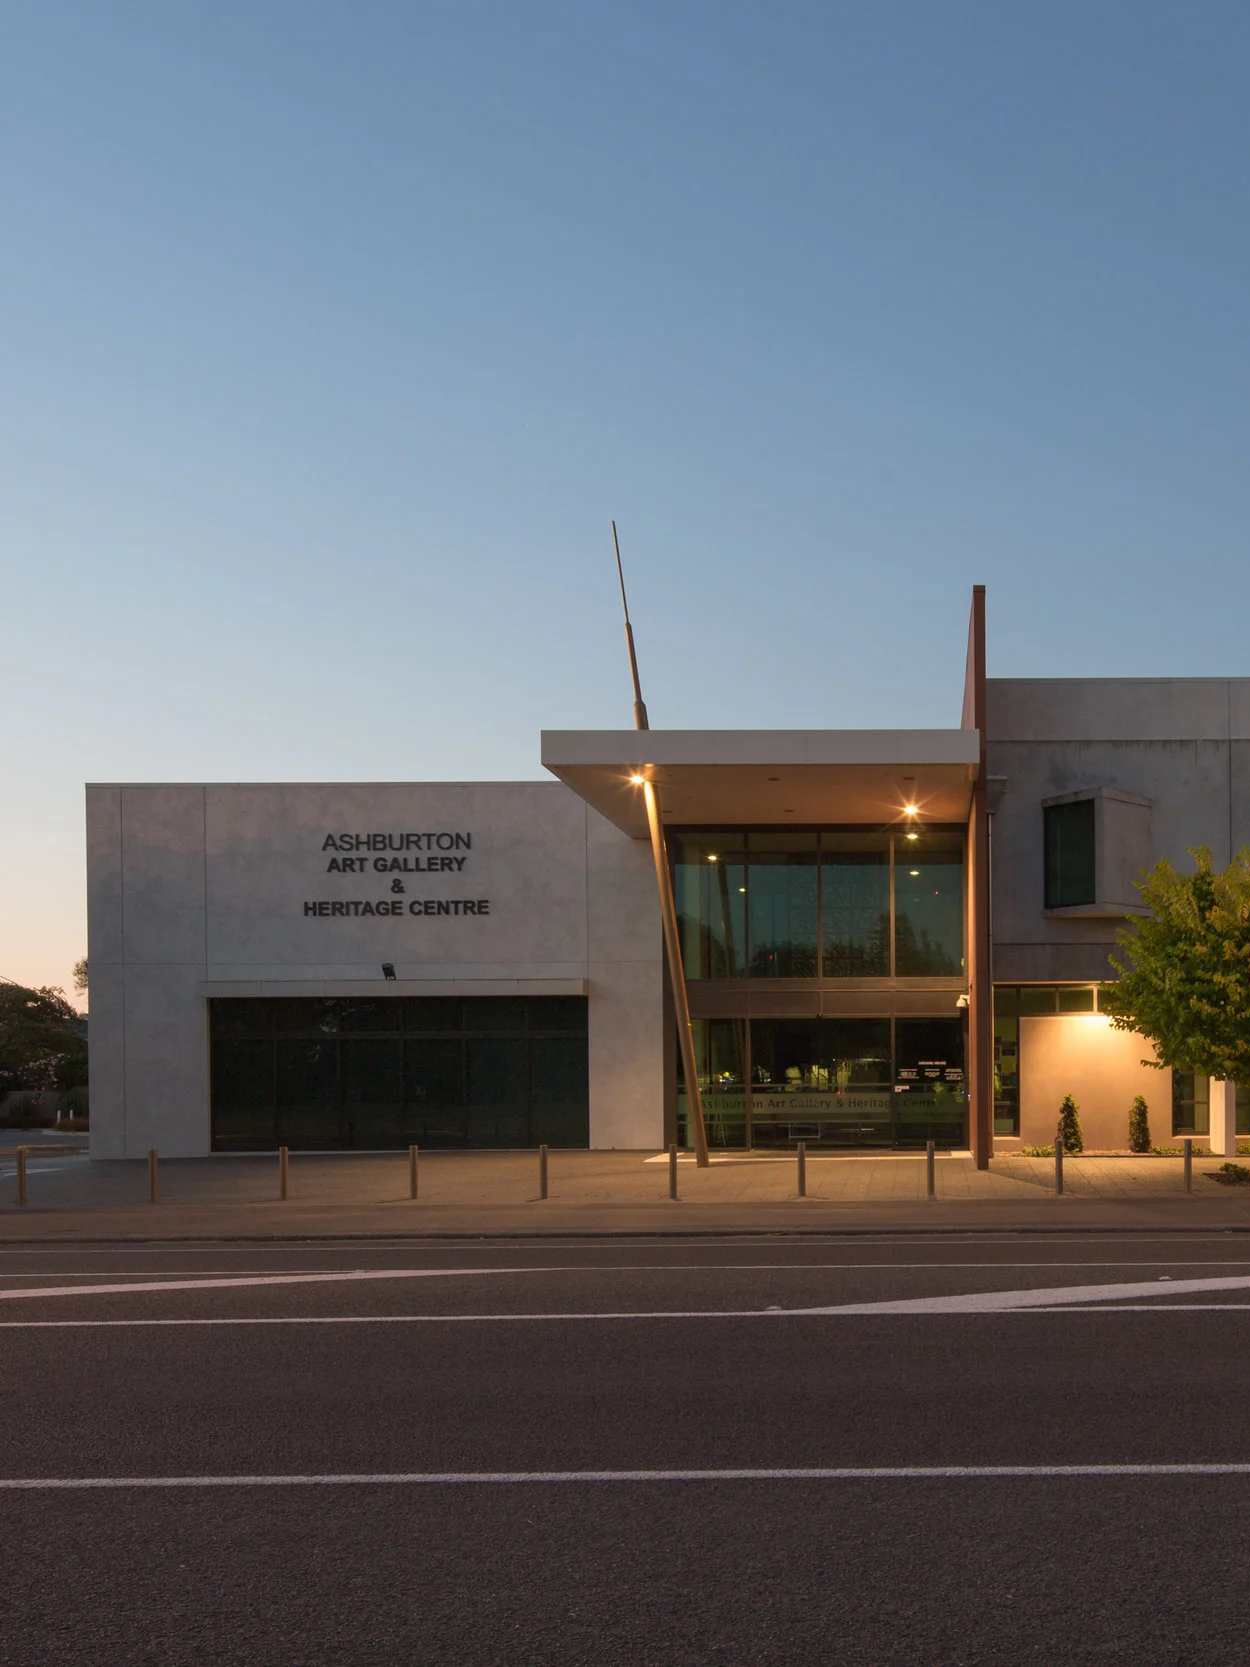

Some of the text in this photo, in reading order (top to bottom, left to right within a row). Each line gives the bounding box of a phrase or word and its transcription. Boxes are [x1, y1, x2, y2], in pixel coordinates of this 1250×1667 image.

[321, 832, 472, 851] ASHBURTON
[326, 856, 467, 873] ART GALLERY
[390, 878, 405, 894] &
[303, 900, 490, 917] HERITAGE CENTRE
[767, 1098, 785, 1109] Art
[836, 1098, 844, 1109] &
